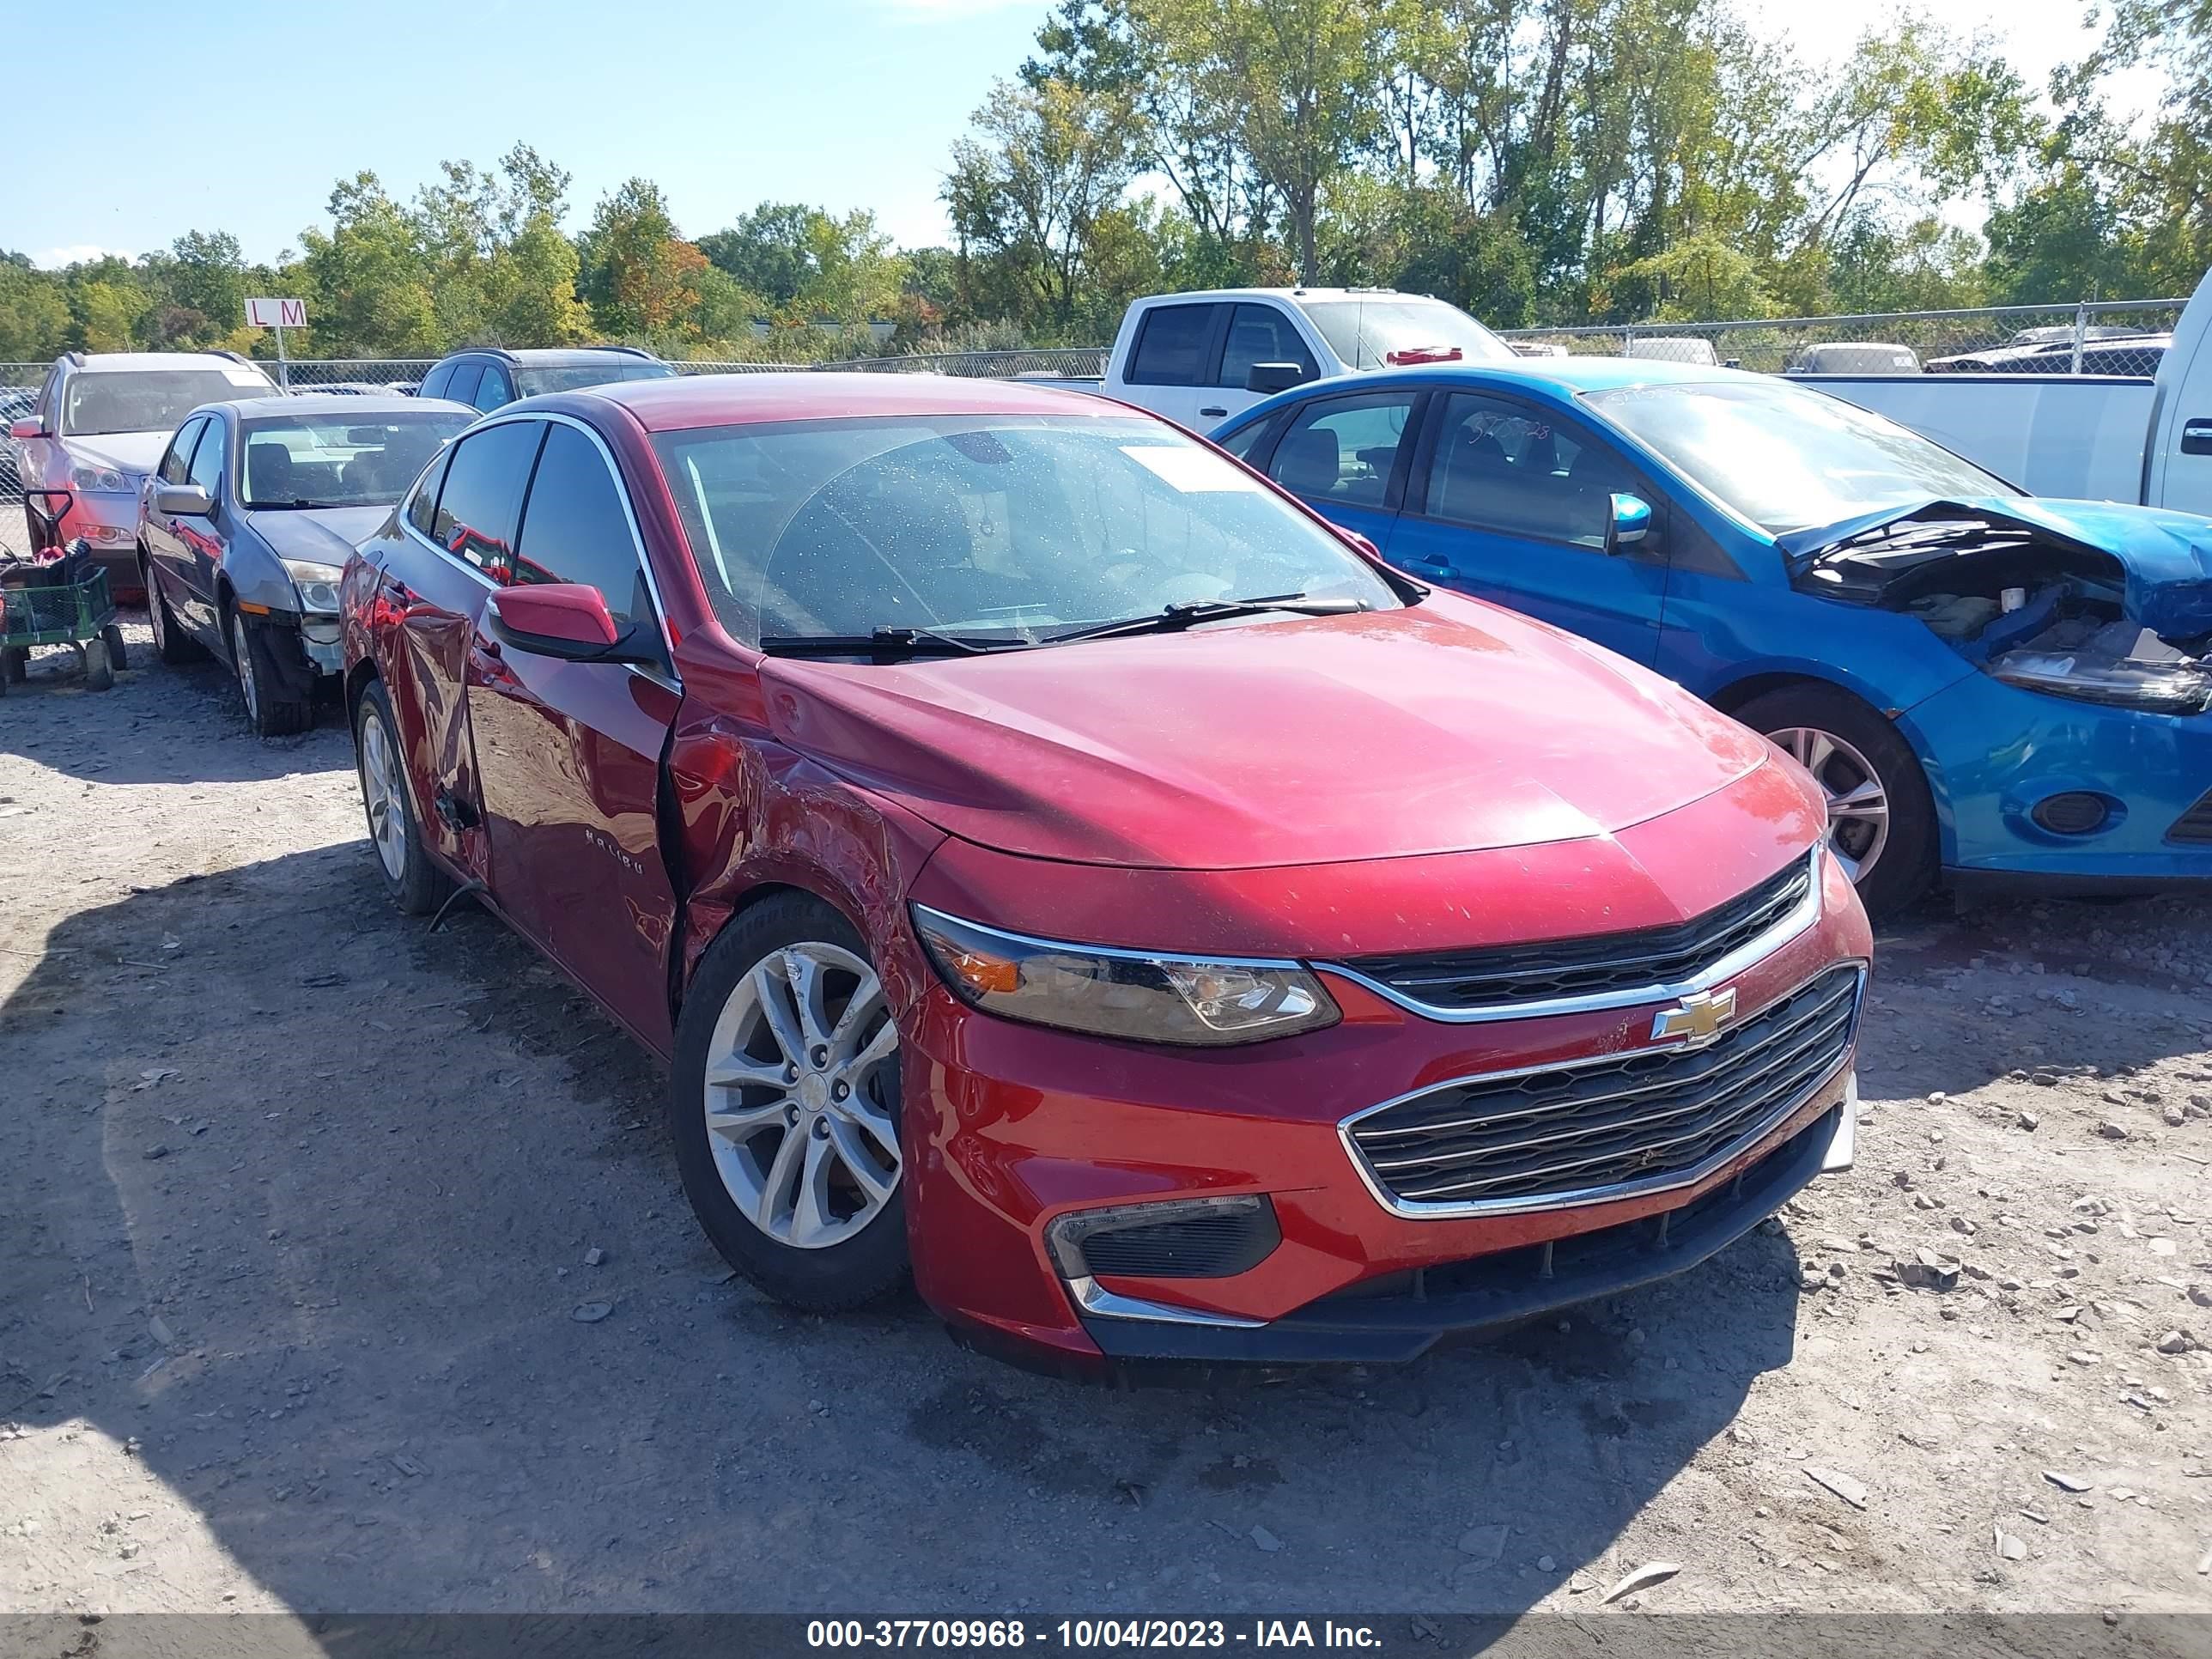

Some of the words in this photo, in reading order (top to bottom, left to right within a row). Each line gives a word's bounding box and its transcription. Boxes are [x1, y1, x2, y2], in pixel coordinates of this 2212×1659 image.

[251, 300, 268, 325] L
[281, 300, 305, 325] M
[584, 829, 643, 875] MALIBU
